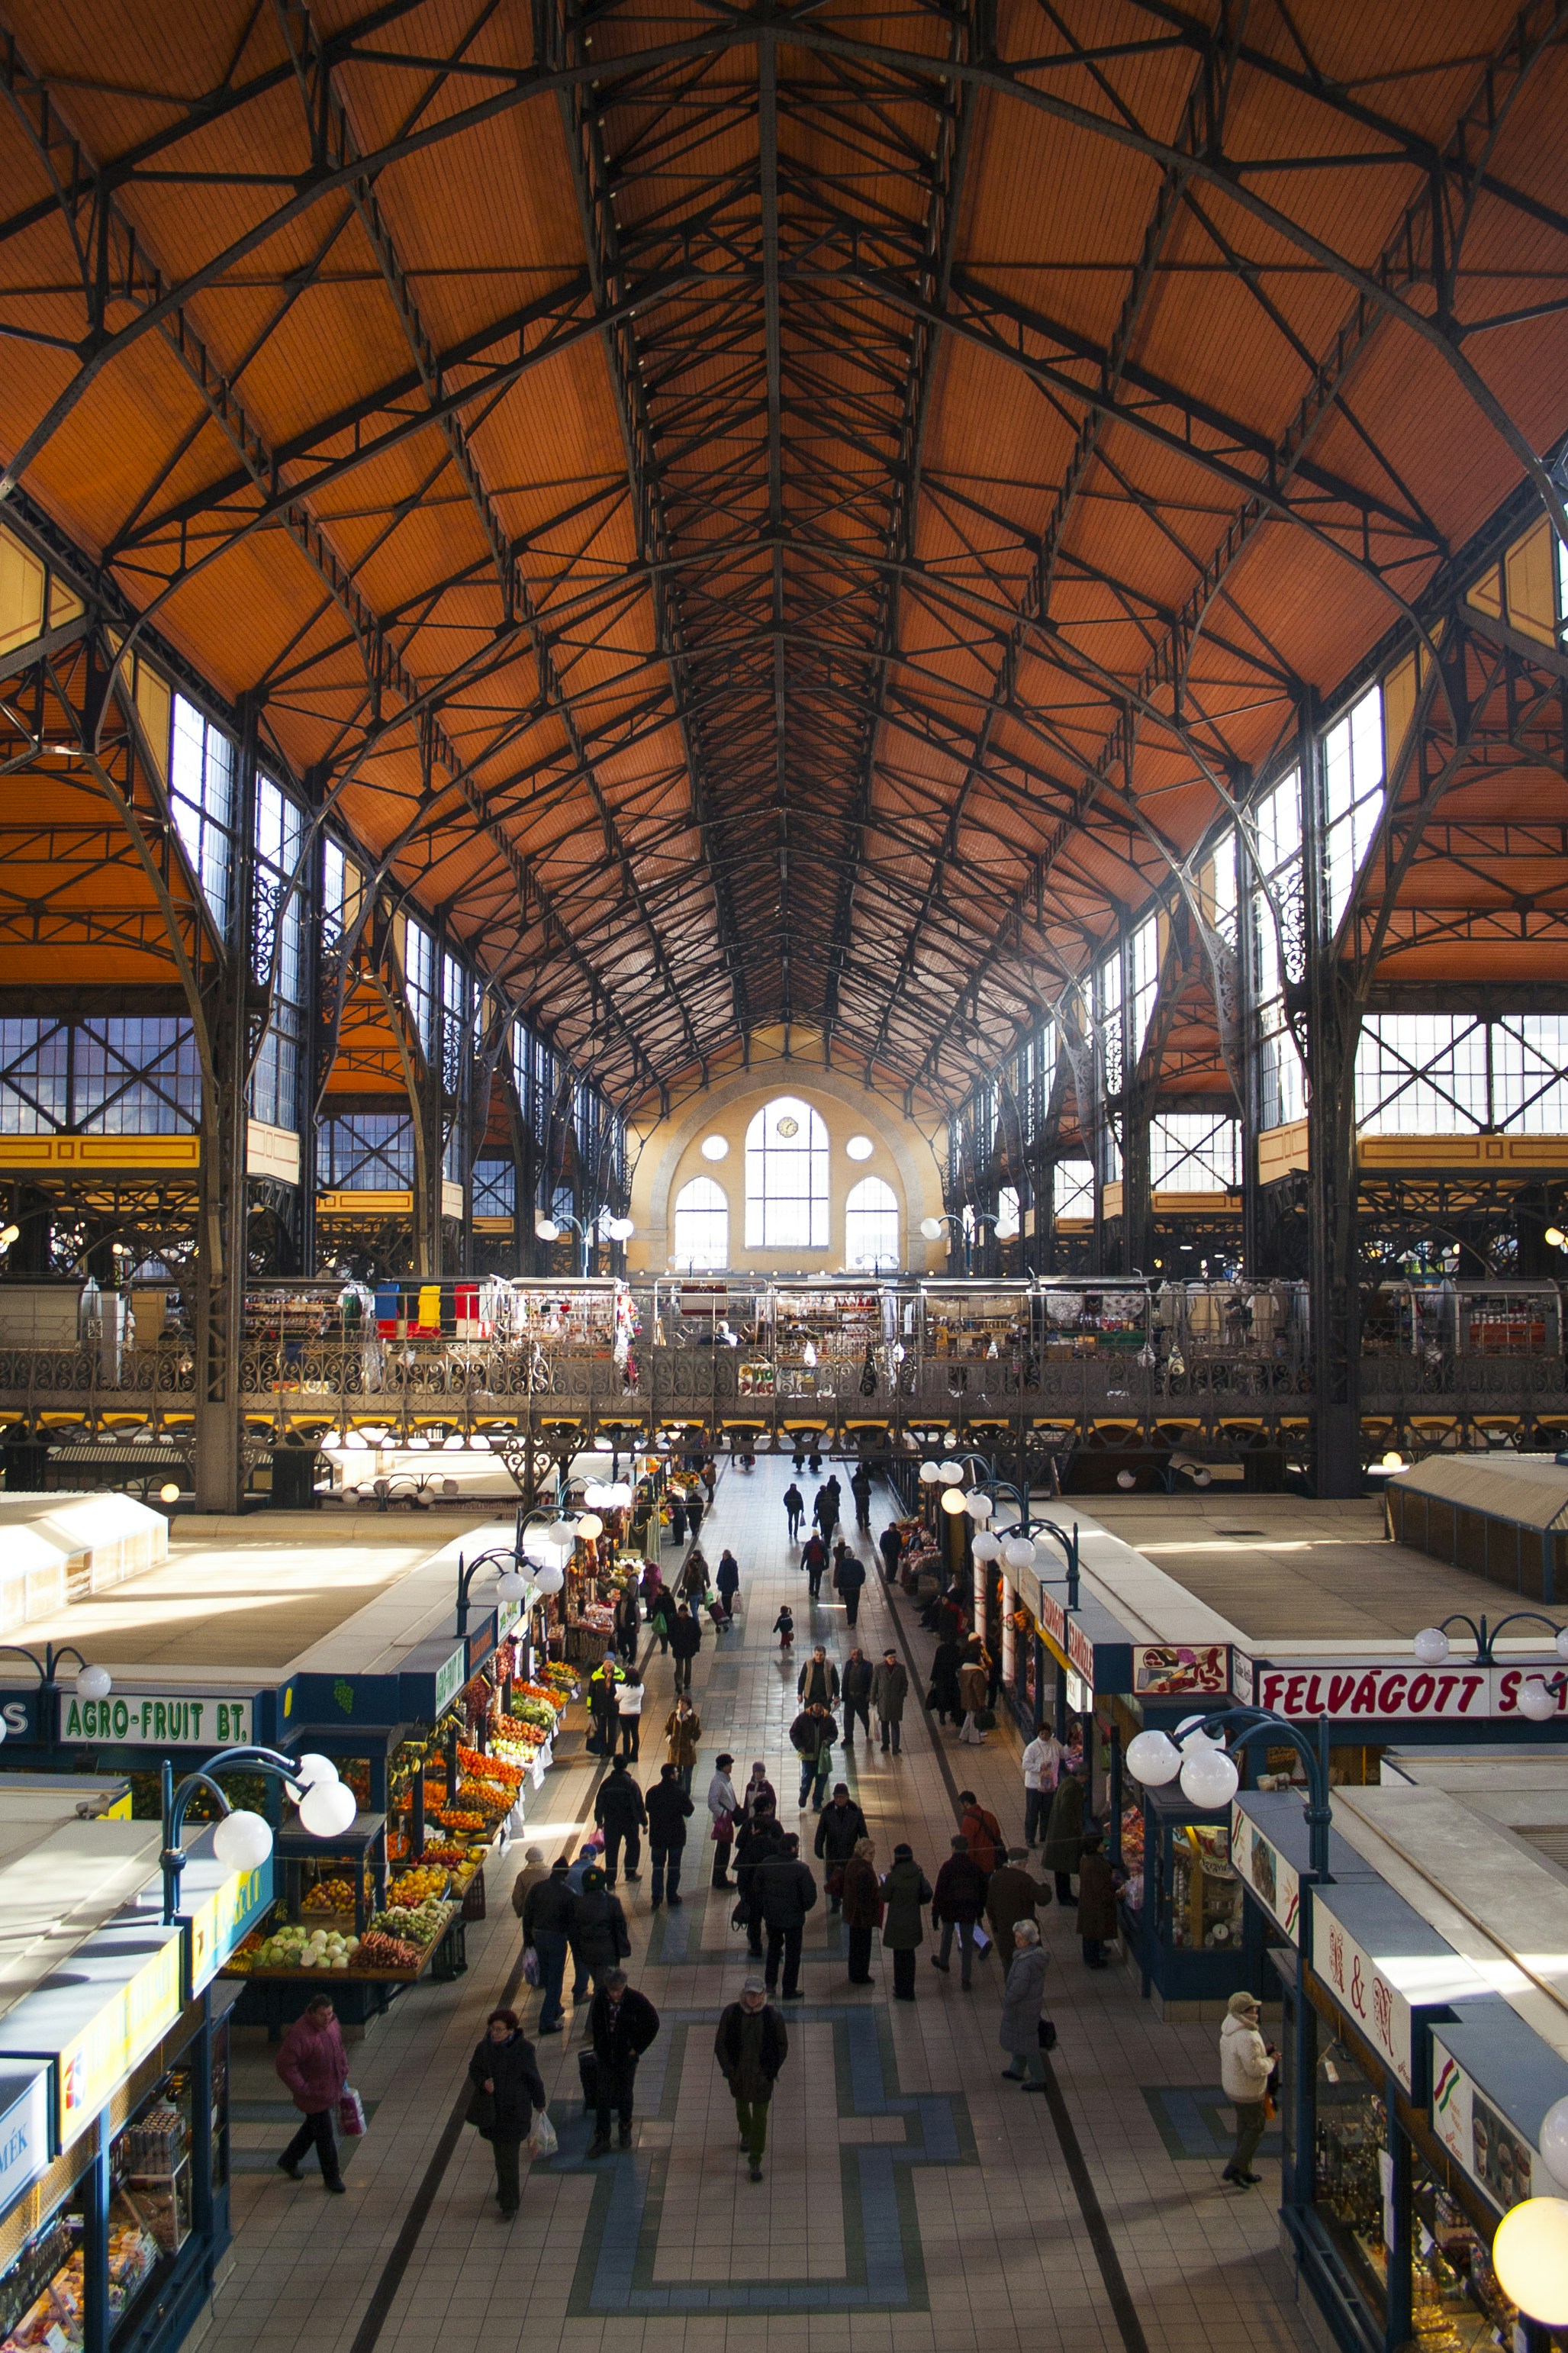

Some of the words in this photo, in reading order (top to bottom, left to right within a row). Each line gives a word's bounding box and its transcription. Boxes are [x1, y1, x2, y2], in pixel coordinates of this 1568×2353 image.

[1263, 1670, 1484, 1714] FELVÁGOTT
[66, 1699, 204, 1740] AGRO-FRUIT
[216, 1703, 247, 1742] BT.
[1351, 1955, 1367, 2019] &
